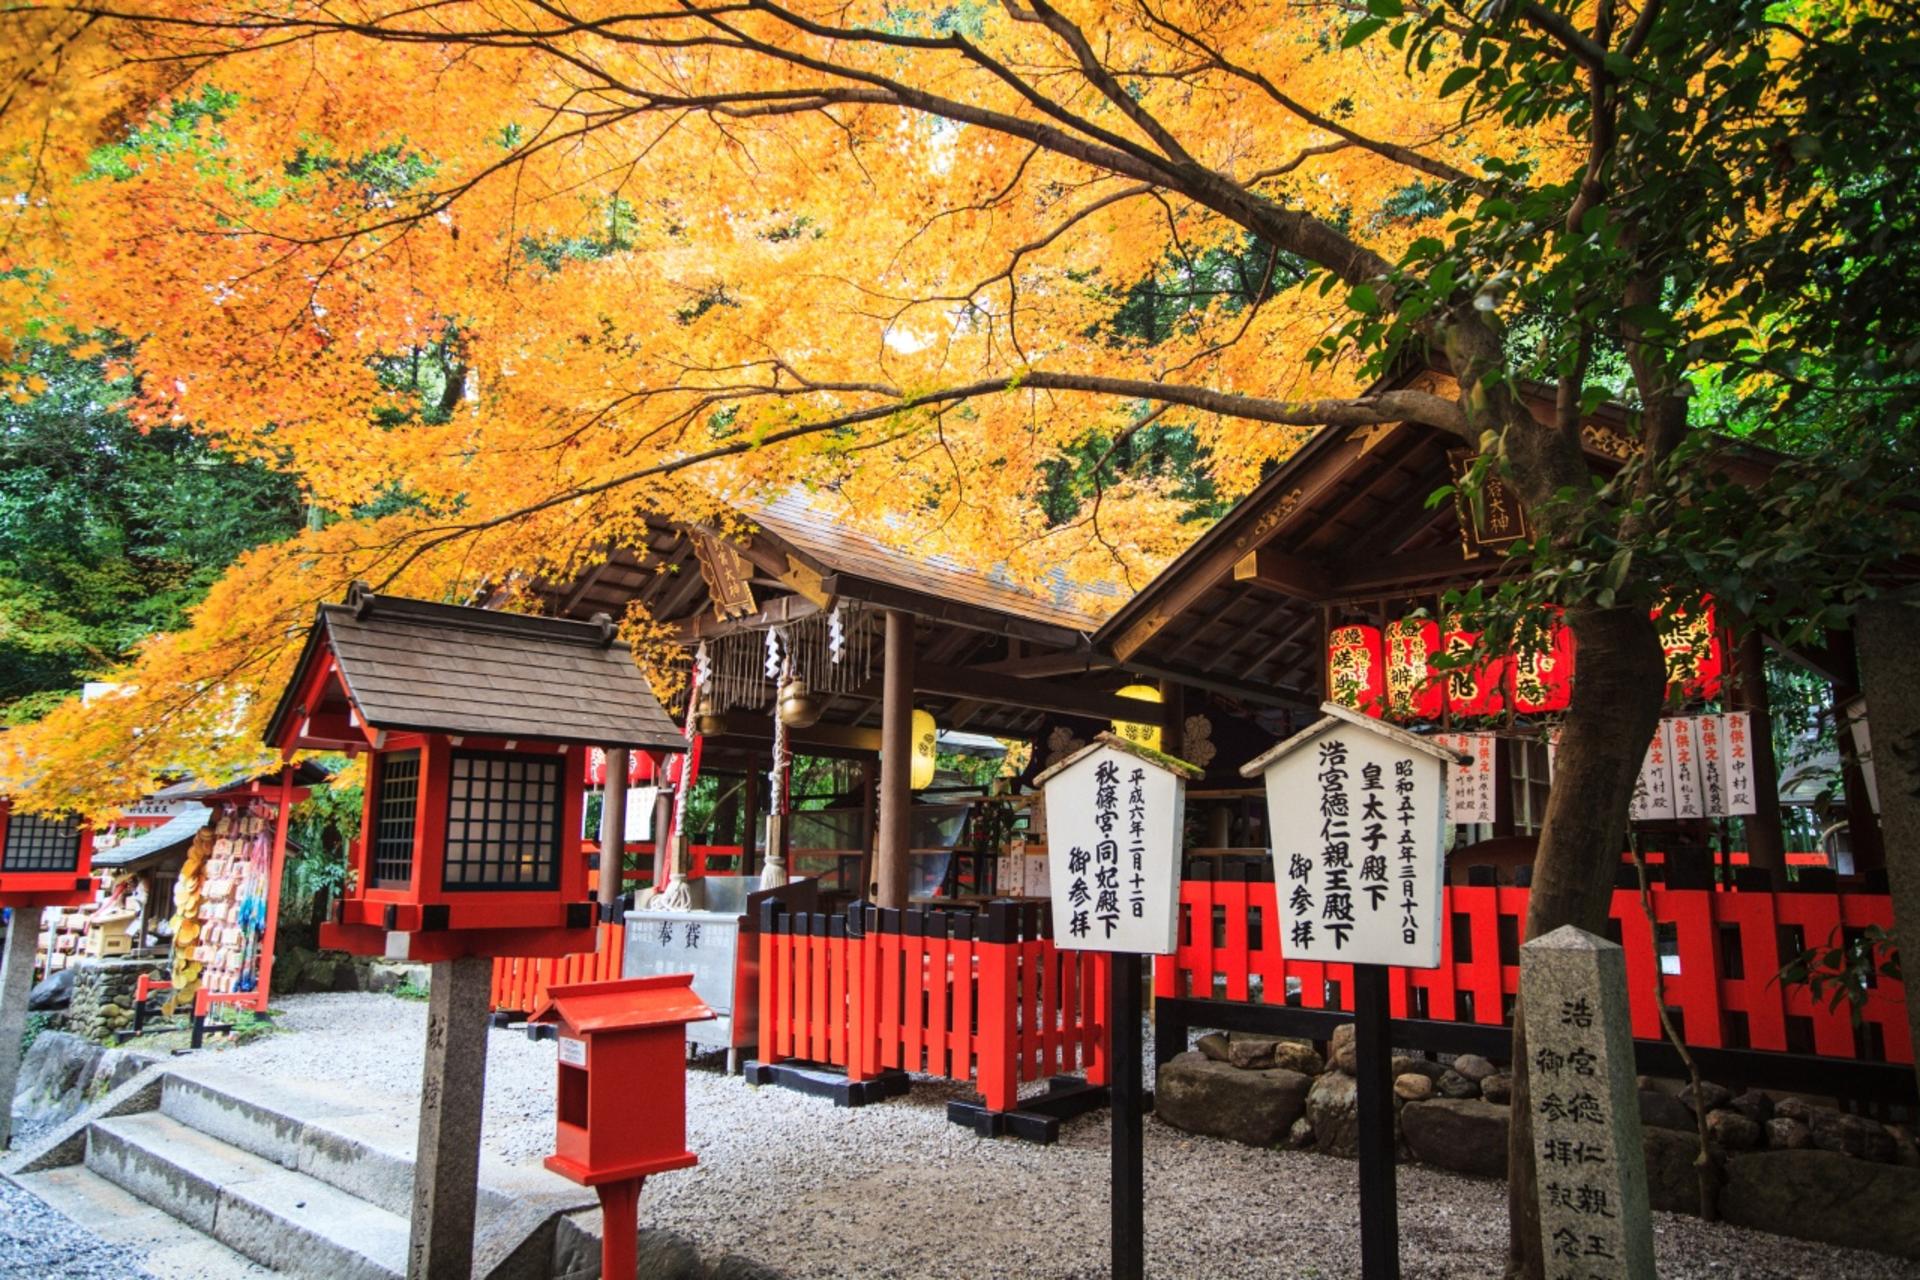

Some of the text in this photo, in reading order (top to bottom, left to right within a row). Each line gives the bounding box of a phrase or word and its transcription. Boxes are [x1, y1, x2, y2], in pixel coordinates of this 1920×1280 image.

[1478, 735, 1490, 773] お供え
[1675, 720, 1691, 763] お供え
[1702, 717, 1719, 761] お供え
[1729, 715, 1750, 805] お供え 中村殿
[1069, 847, 1091, 938] 御参拝
[1094, 760, 1120, 939] 秋篠宮・同妃殿下
[1129, 768, 1146, 918] 平成六年二月十二日
[1288, 853, 1314, 950] 御参拝
[1319, 741, 1355, 950] 浩宮徳仁親王殿下
[1360, 763, 1388, 911] 皇太子殿下
[1395, 759, 1418, 945] 昭和五十五年三月十八日
[1536, 1049, 1580, 1280] 御参拝記念
[1561, 998, 1615, 1280] 浩宮徳仁親王
